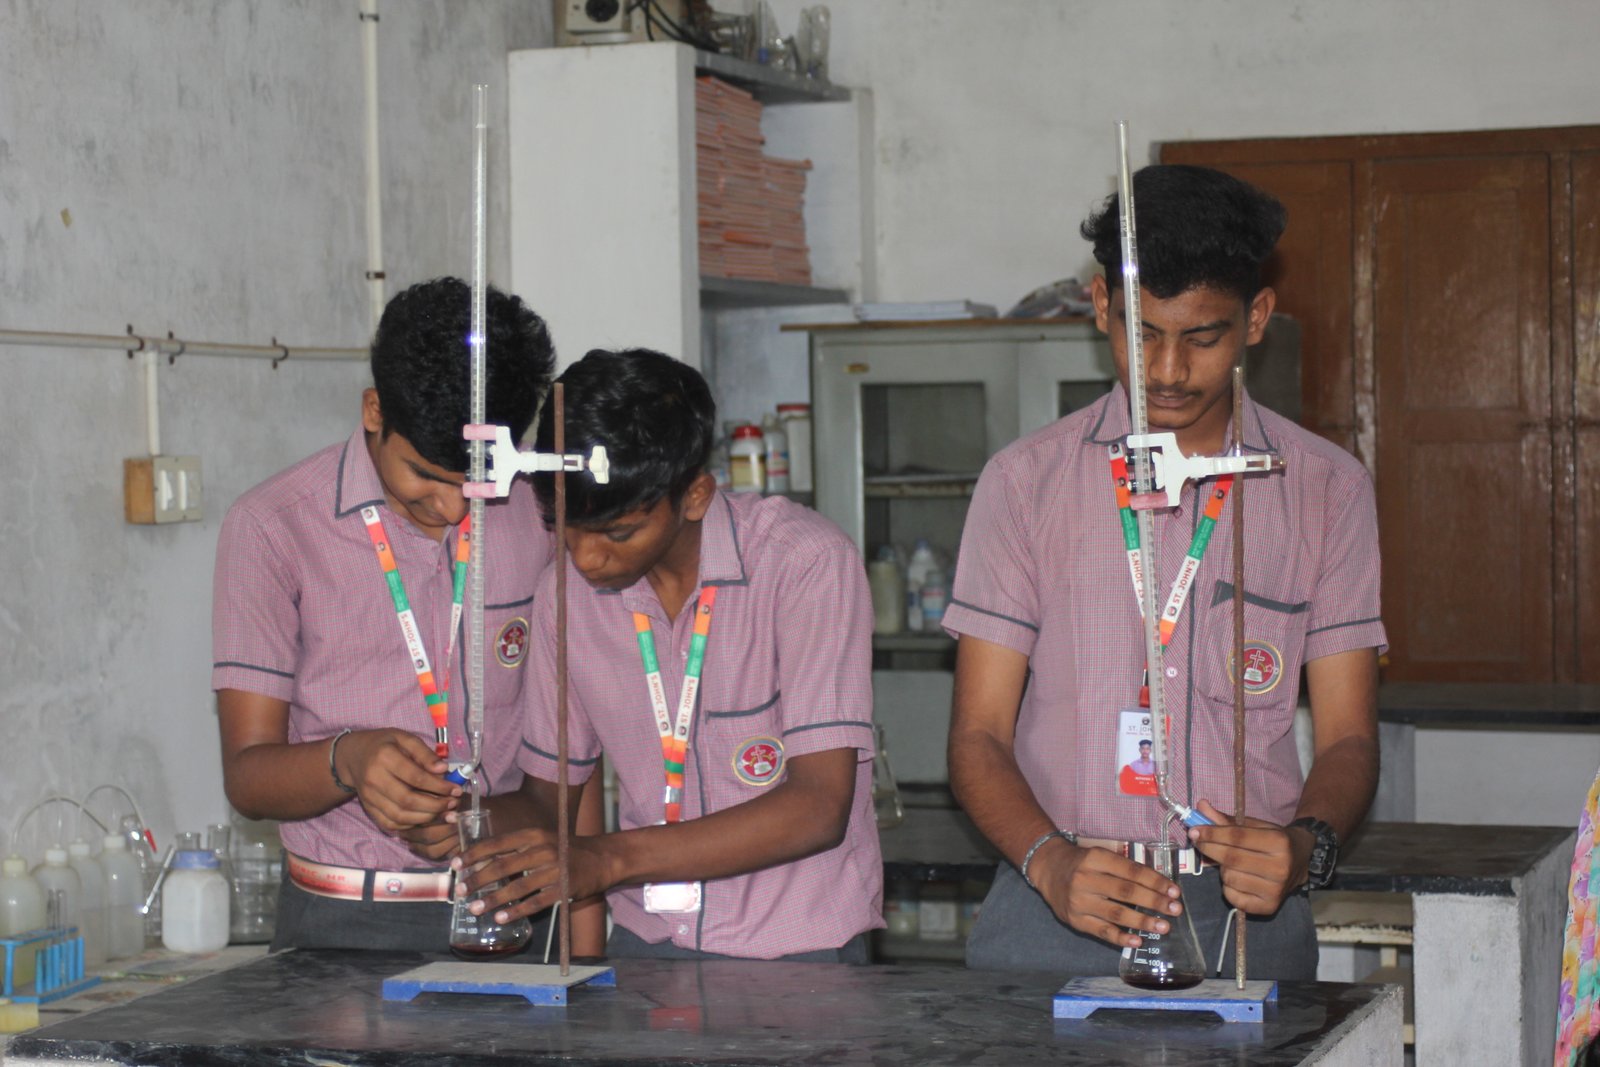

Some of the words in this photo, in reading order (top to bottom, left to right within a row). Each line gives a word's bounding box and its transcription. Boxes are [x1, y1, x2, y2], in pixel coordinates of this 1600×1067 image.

[1178, 560, 1196, 590] JOHN'S
[1148, 932, 1160, 940] 200
[1148, 959, 1161, 967] 100
